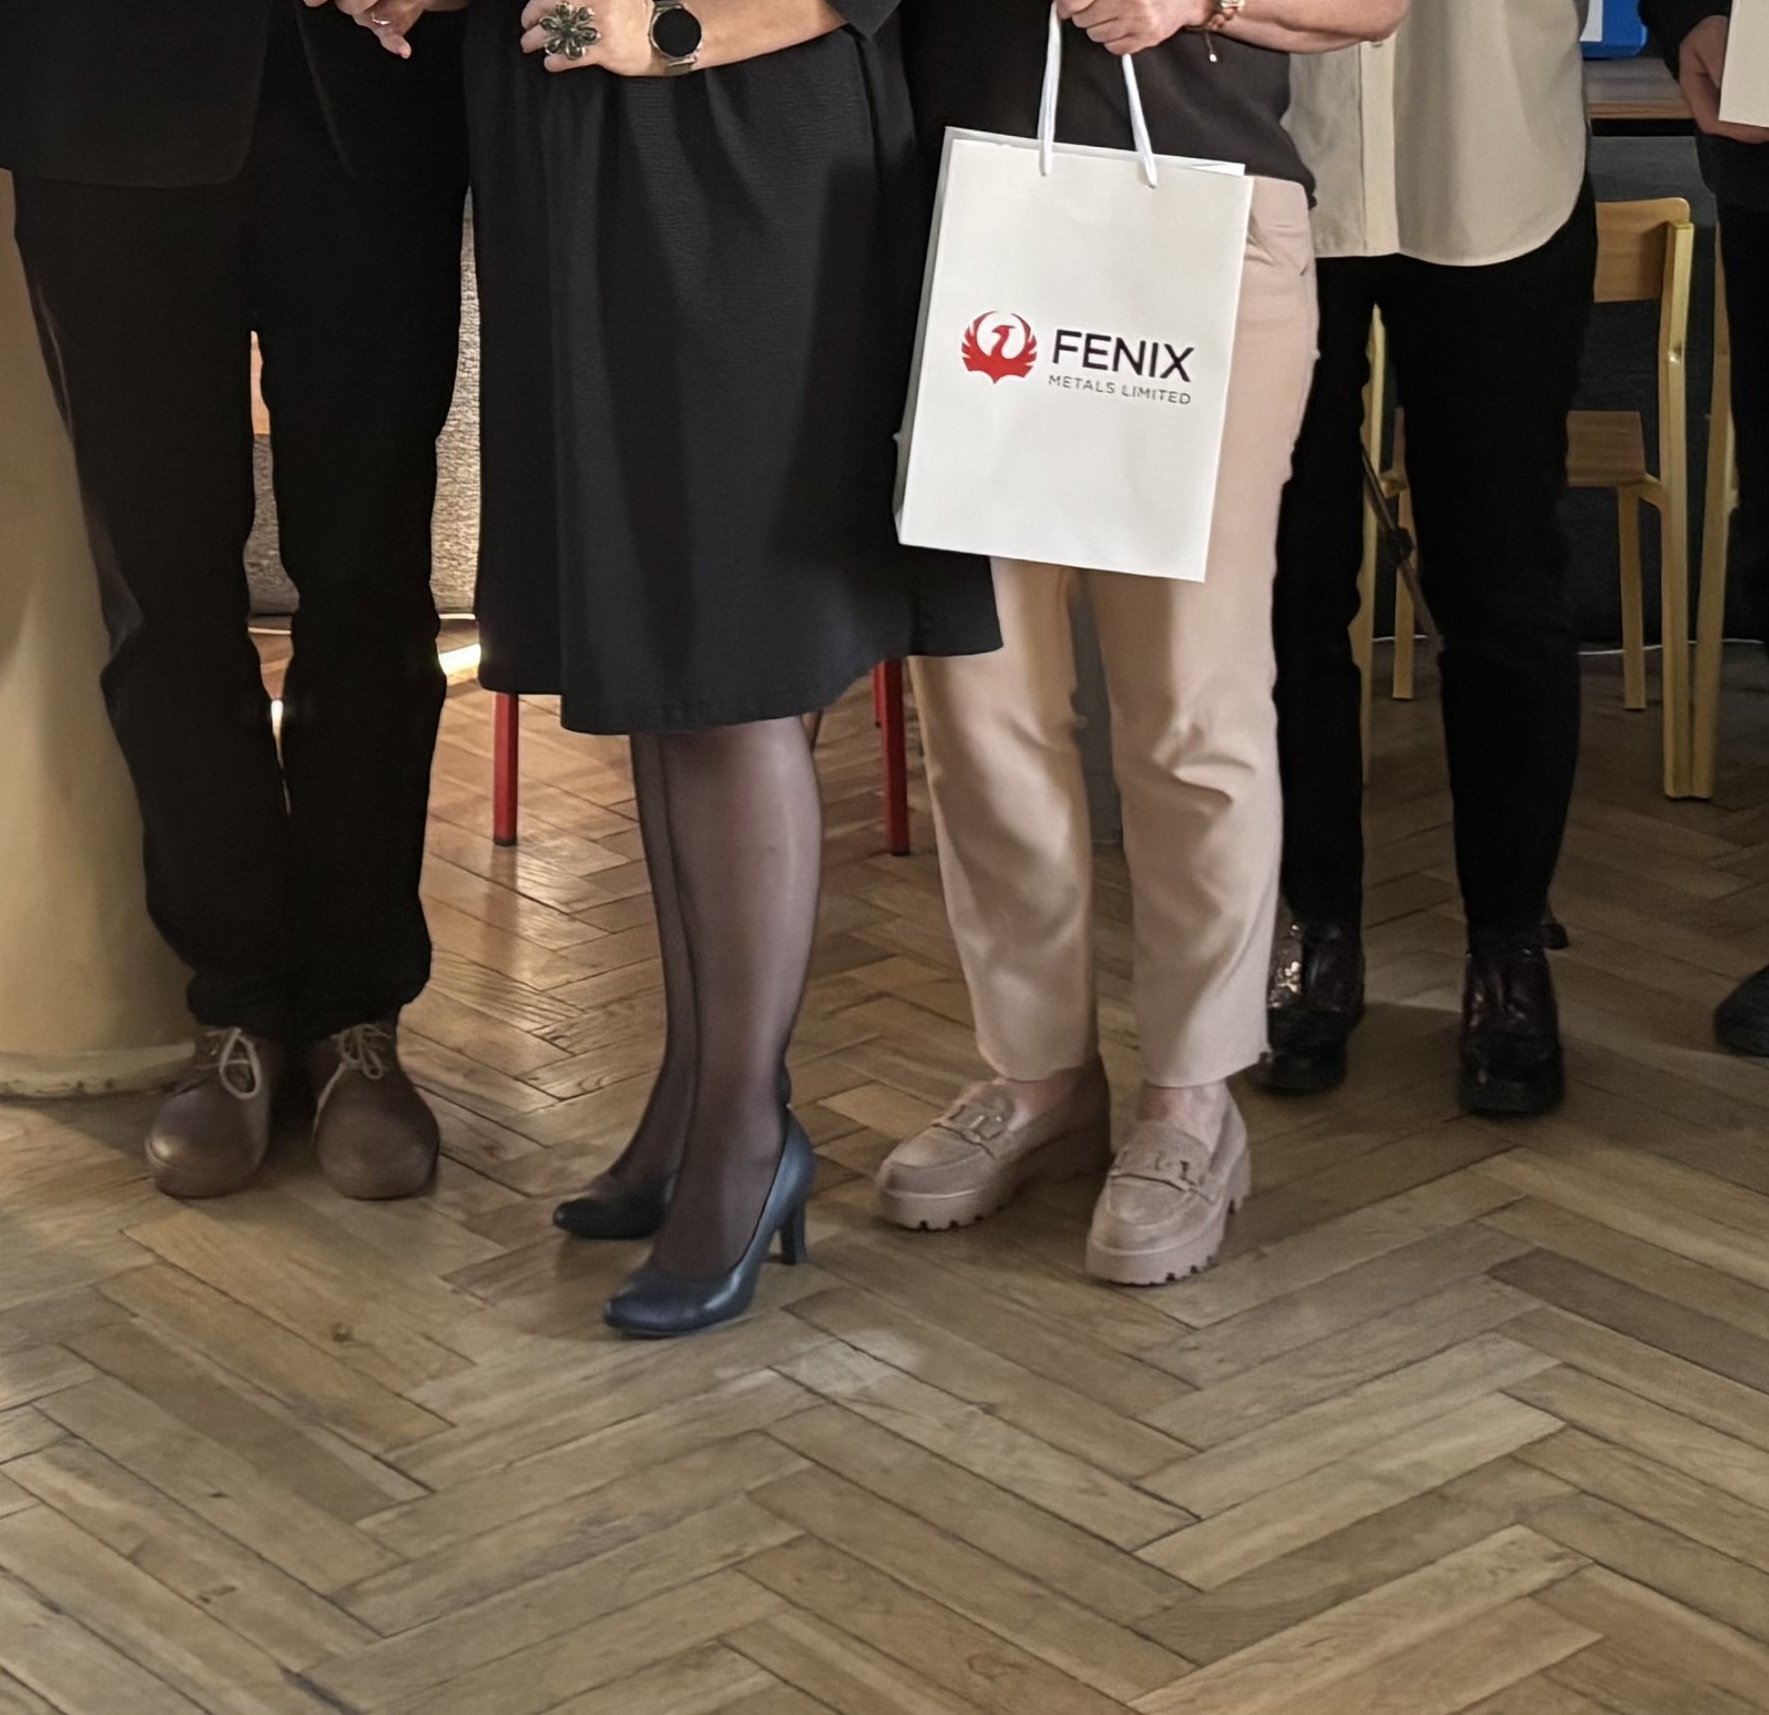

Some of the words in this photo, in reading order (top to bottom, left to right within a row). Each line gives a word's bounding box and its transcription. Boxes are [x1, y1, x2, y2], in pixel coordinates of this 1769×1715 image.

[1052, 328, 1195, 384] FENIX
[1048, 374, 1116, 395] METALS
[1121, 384, 1192, 406] LIMITED
